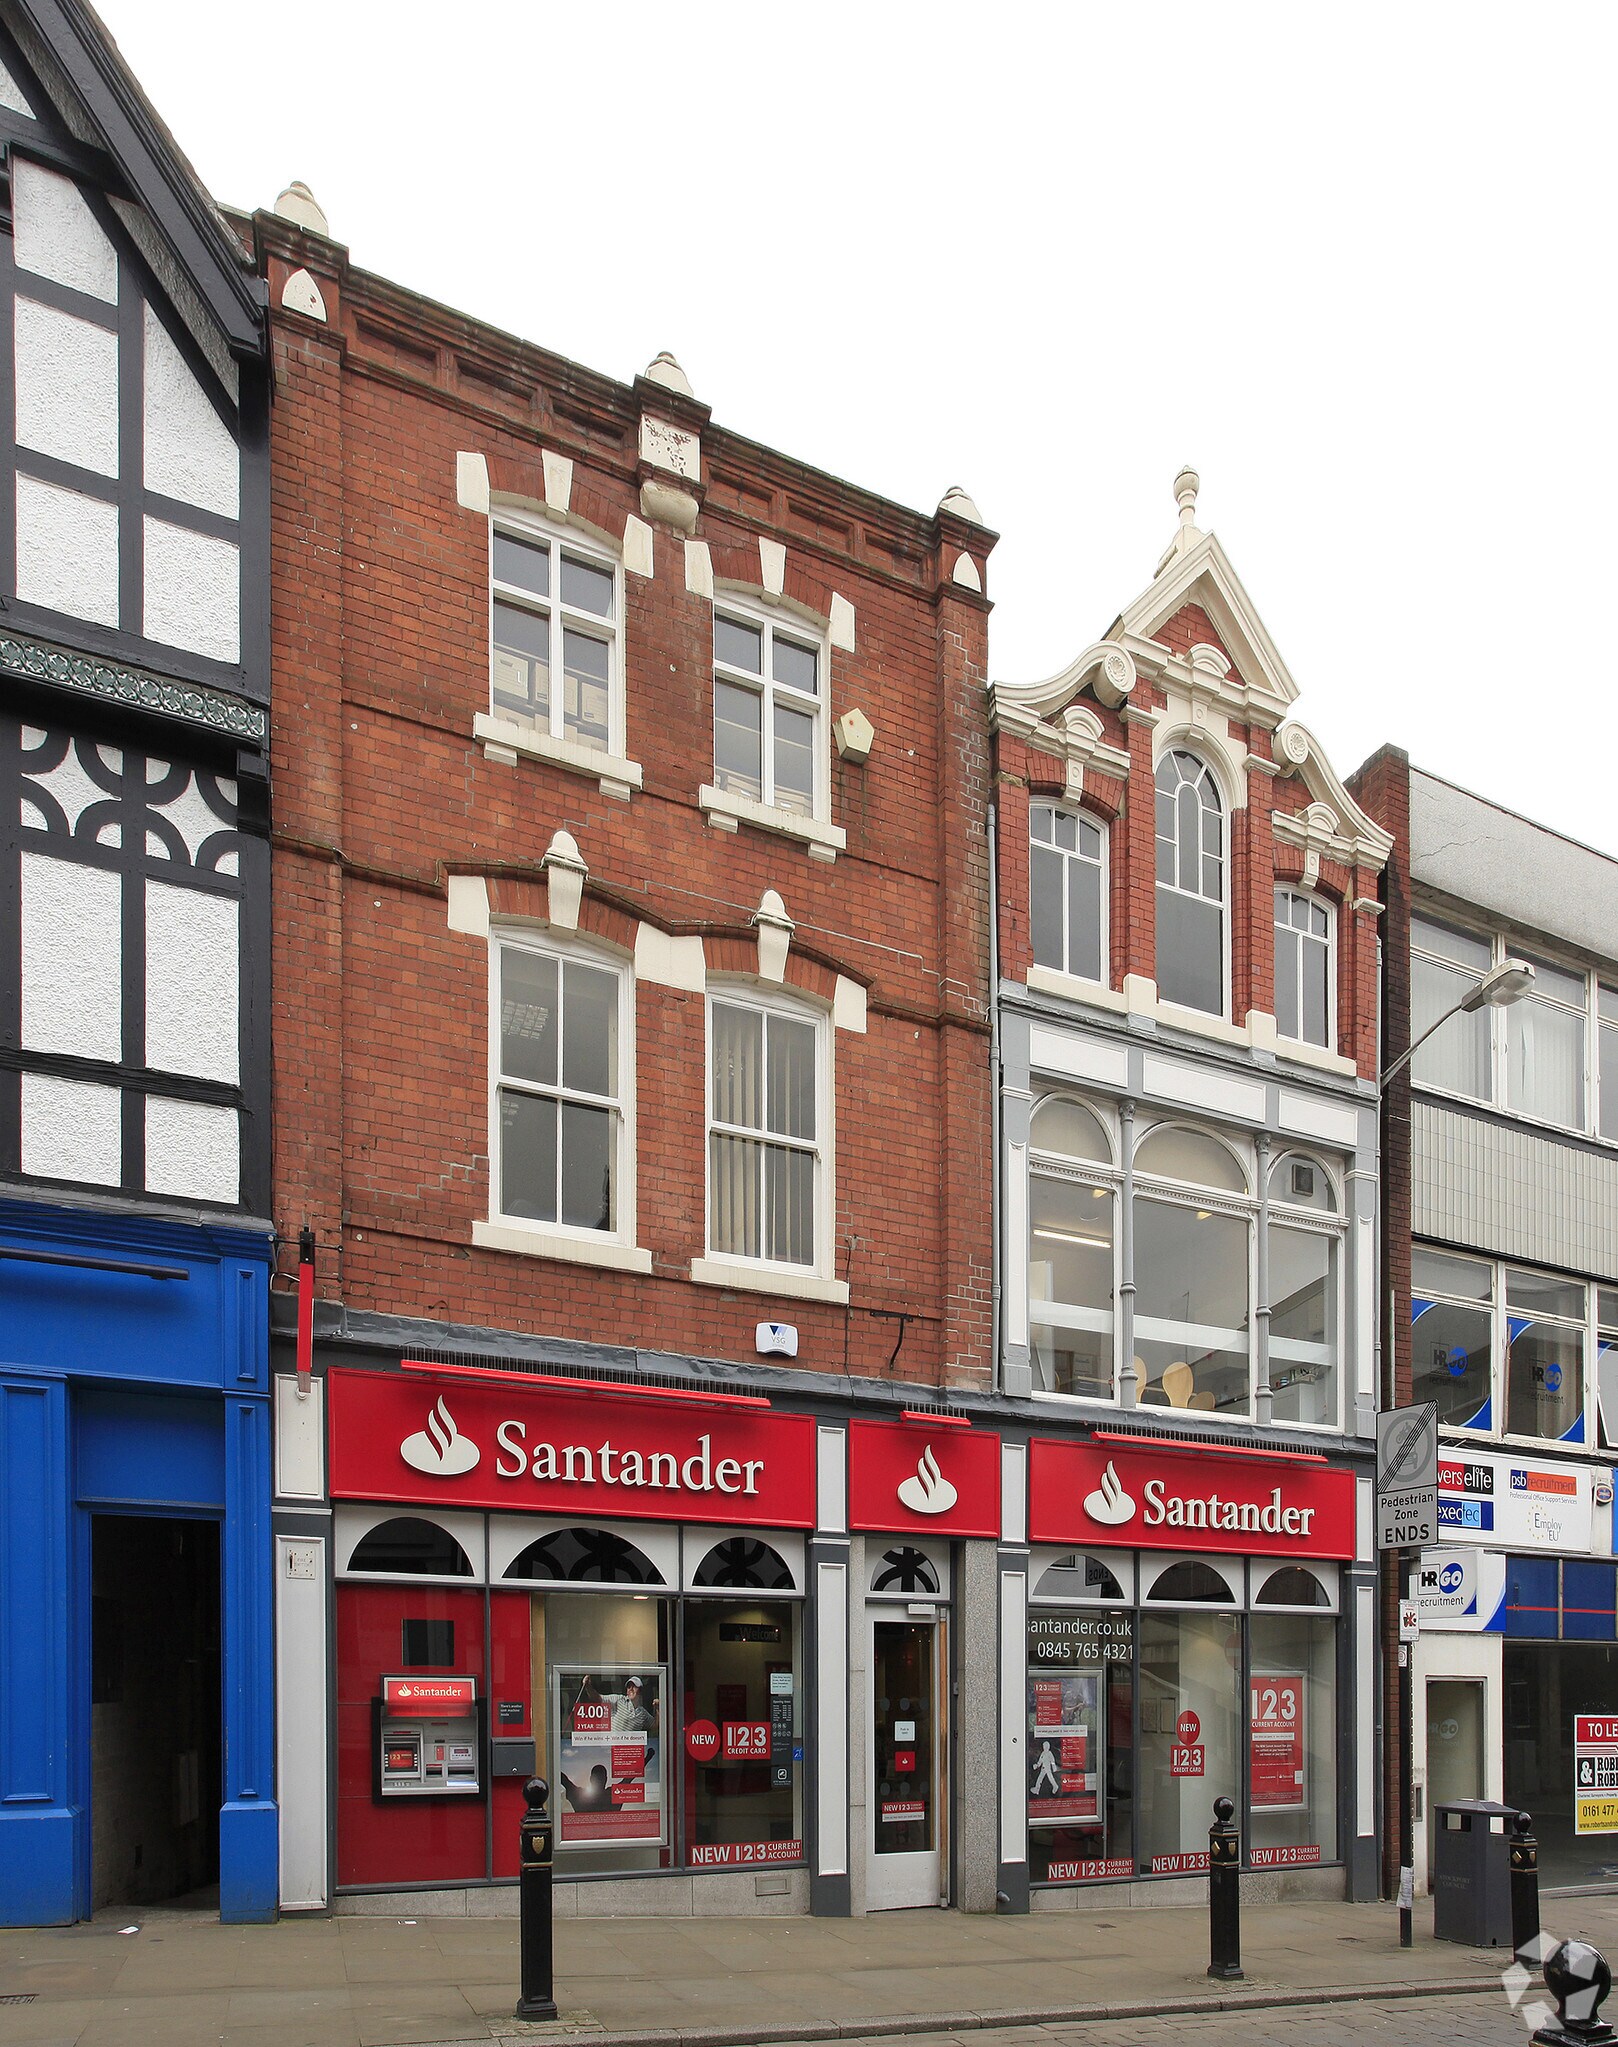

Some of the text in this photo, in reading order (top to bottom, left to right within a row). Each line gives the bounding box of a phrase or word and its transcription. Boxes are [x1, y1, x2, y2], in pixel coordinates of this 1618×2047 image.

[771, 1336, 786, 1344] VSG
[496, 1419, 765, 1495] Santander
[1381, 1492, 1434, 1508] Pedestrian
[1510, 1491, 1533, 1501] Professional
[1545, 1495, 1561, 1504] Support
[1143, 1479, 1315, 1536] Santander
[1394, 1509, 1419, 1520] Zone
[1534, 1512, 1563, 1533] Employ
[1385, 1523, 1430, 1544] ENDS
[1548, 1530, 1559, 1541] EU
[1420, 1596, 1464, 1607] ecruitment
[1037, 1641, 1133, 1660] 0845 765 4321
[413, 1686, 462, 1697] Santander
[1180, 1723, 1197, 1732] NEW
[1587, 1723, 1603, 1737] TO
[691, 1734, 715, 1745] NEW
[727, 1747, 748, 1755] CREDIT
[883, 1804, 898, 1812] NEW
[1582, 1805, 1600, 1817] 0161
[1602, 1804, 1615, 1816] 477
[692, 1845, 731, 1864] NEW
[767, 1841, 801, 1851] CURRENT
[767, 1850, 801, 1860] ACCOUNT
[1297, 1846, 1319, 1854] CURRENT
[1297, 1853, 1319, 1861] ACCOUNT
[1048, 1863, 1078, 1879] NEW
[1106, 1859, 1133, 1868] CURRENT
[1152, 1856, 1180, 1872] NEW
[1106, 1867, 1133, 1875] ACCOUNT
